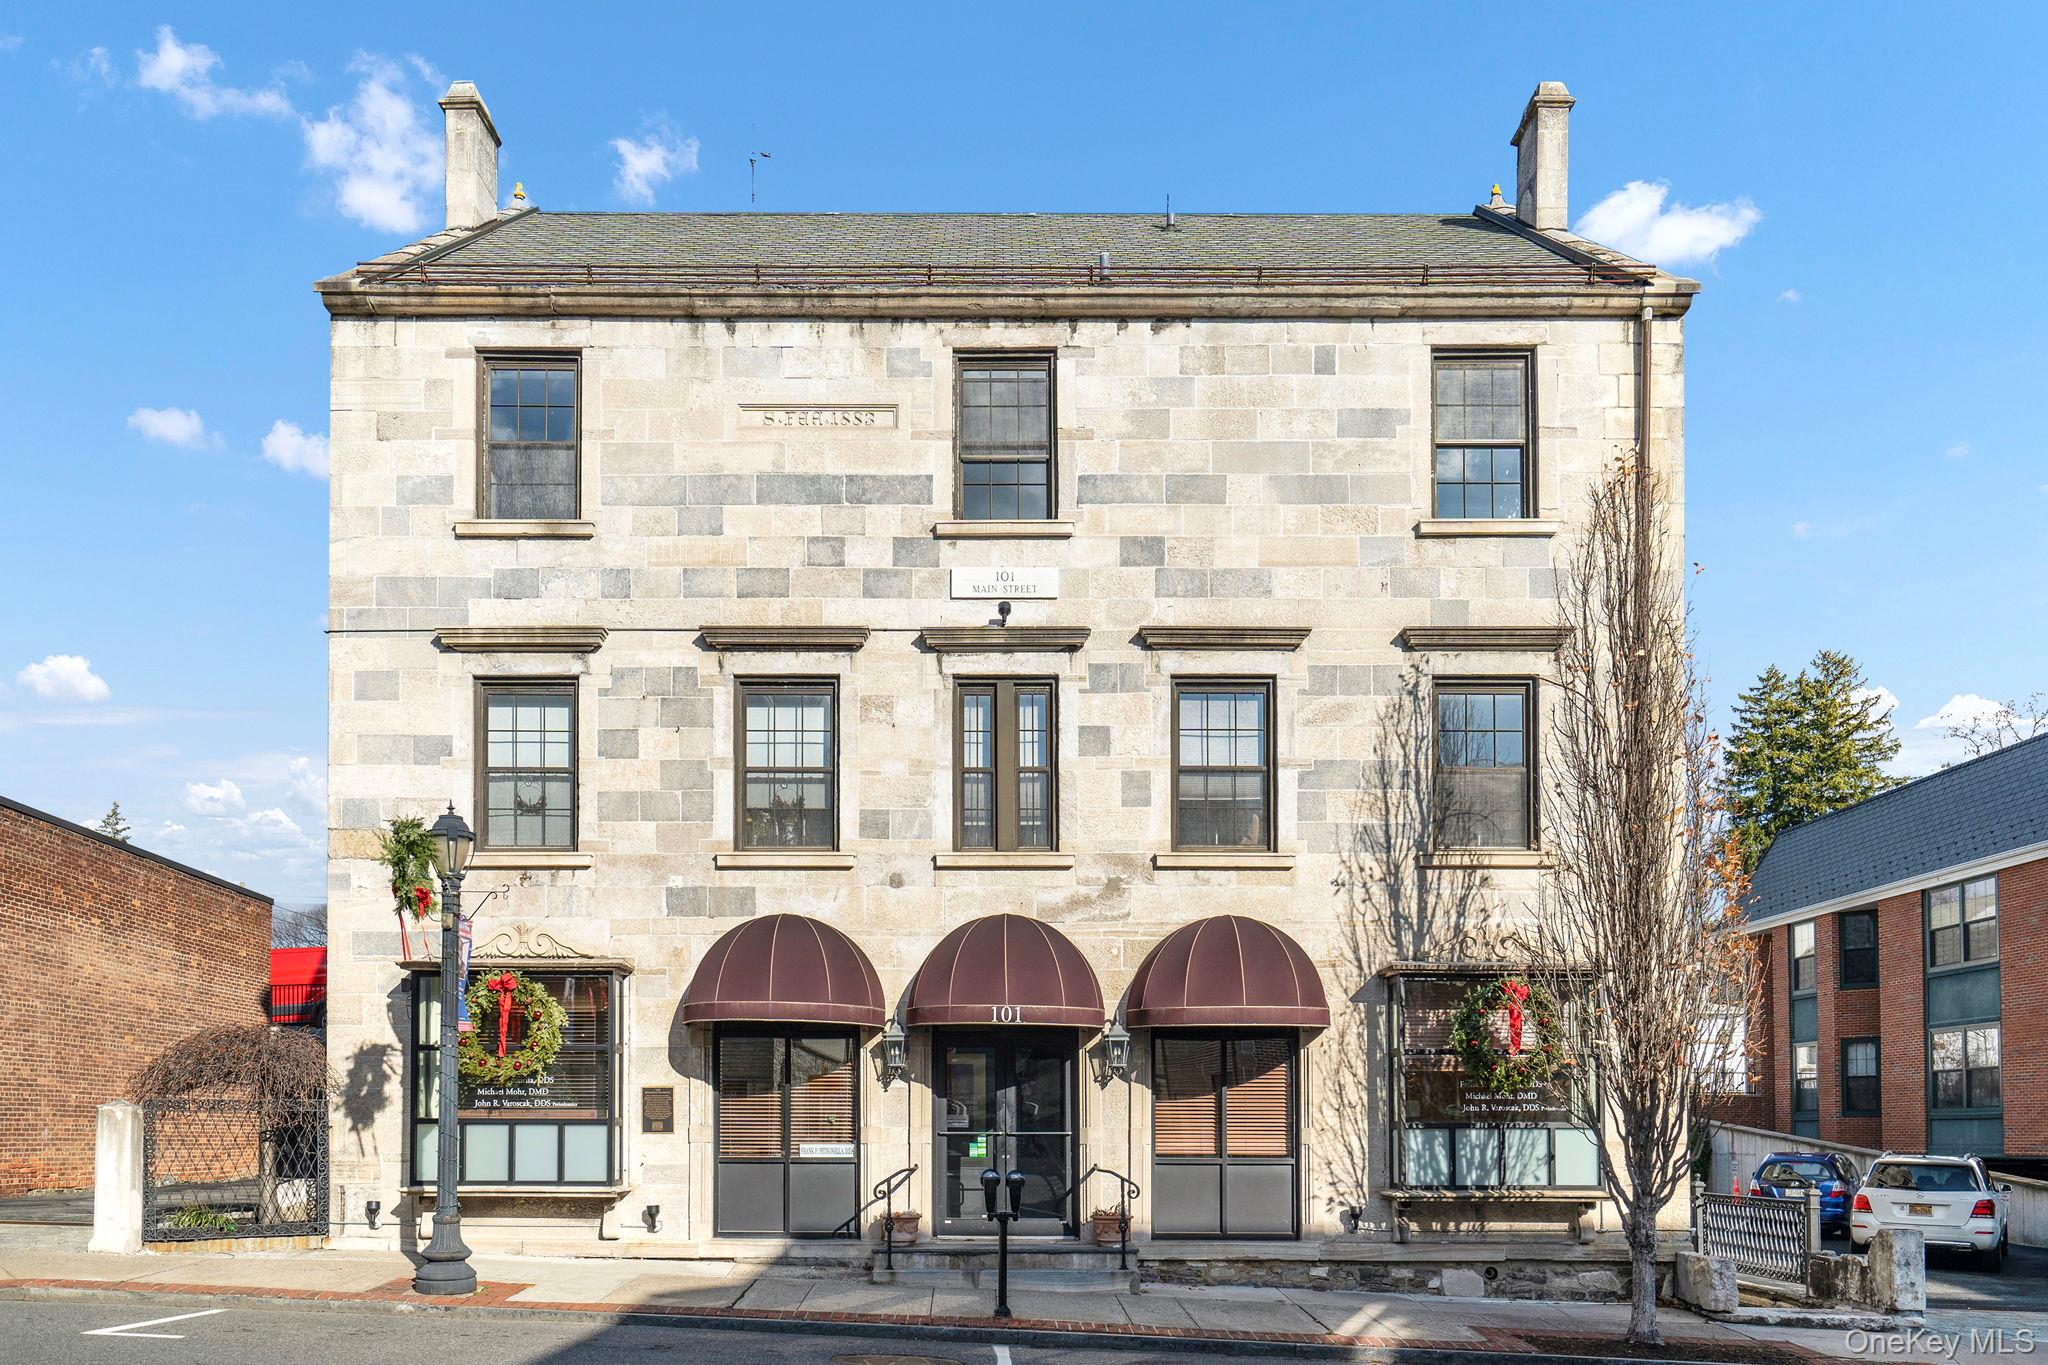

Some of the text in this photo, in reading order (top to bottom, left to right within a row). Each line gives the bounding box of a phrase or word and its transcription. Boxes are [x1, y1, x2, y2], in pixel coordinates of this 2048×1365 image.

[995, 571, 1015, 582] 101
[972, 585, 1038, 594] MAIN STREET
[991, 1005, 1022, 1023] 101
[505, 1088, 527, 1097] Mohr,
[528, 1088, 549, 1096] DMD
[1517, 1092, 1538, 1100] DMD
[474, 1099, 492, 1108] John
[534, 1099, 551, 1107] DDS
[1462, 1103, 1480, 1112] John
[1481, 1103, 1489, 1112] R.
[1522, 1103, 1540, 1112] DDS
